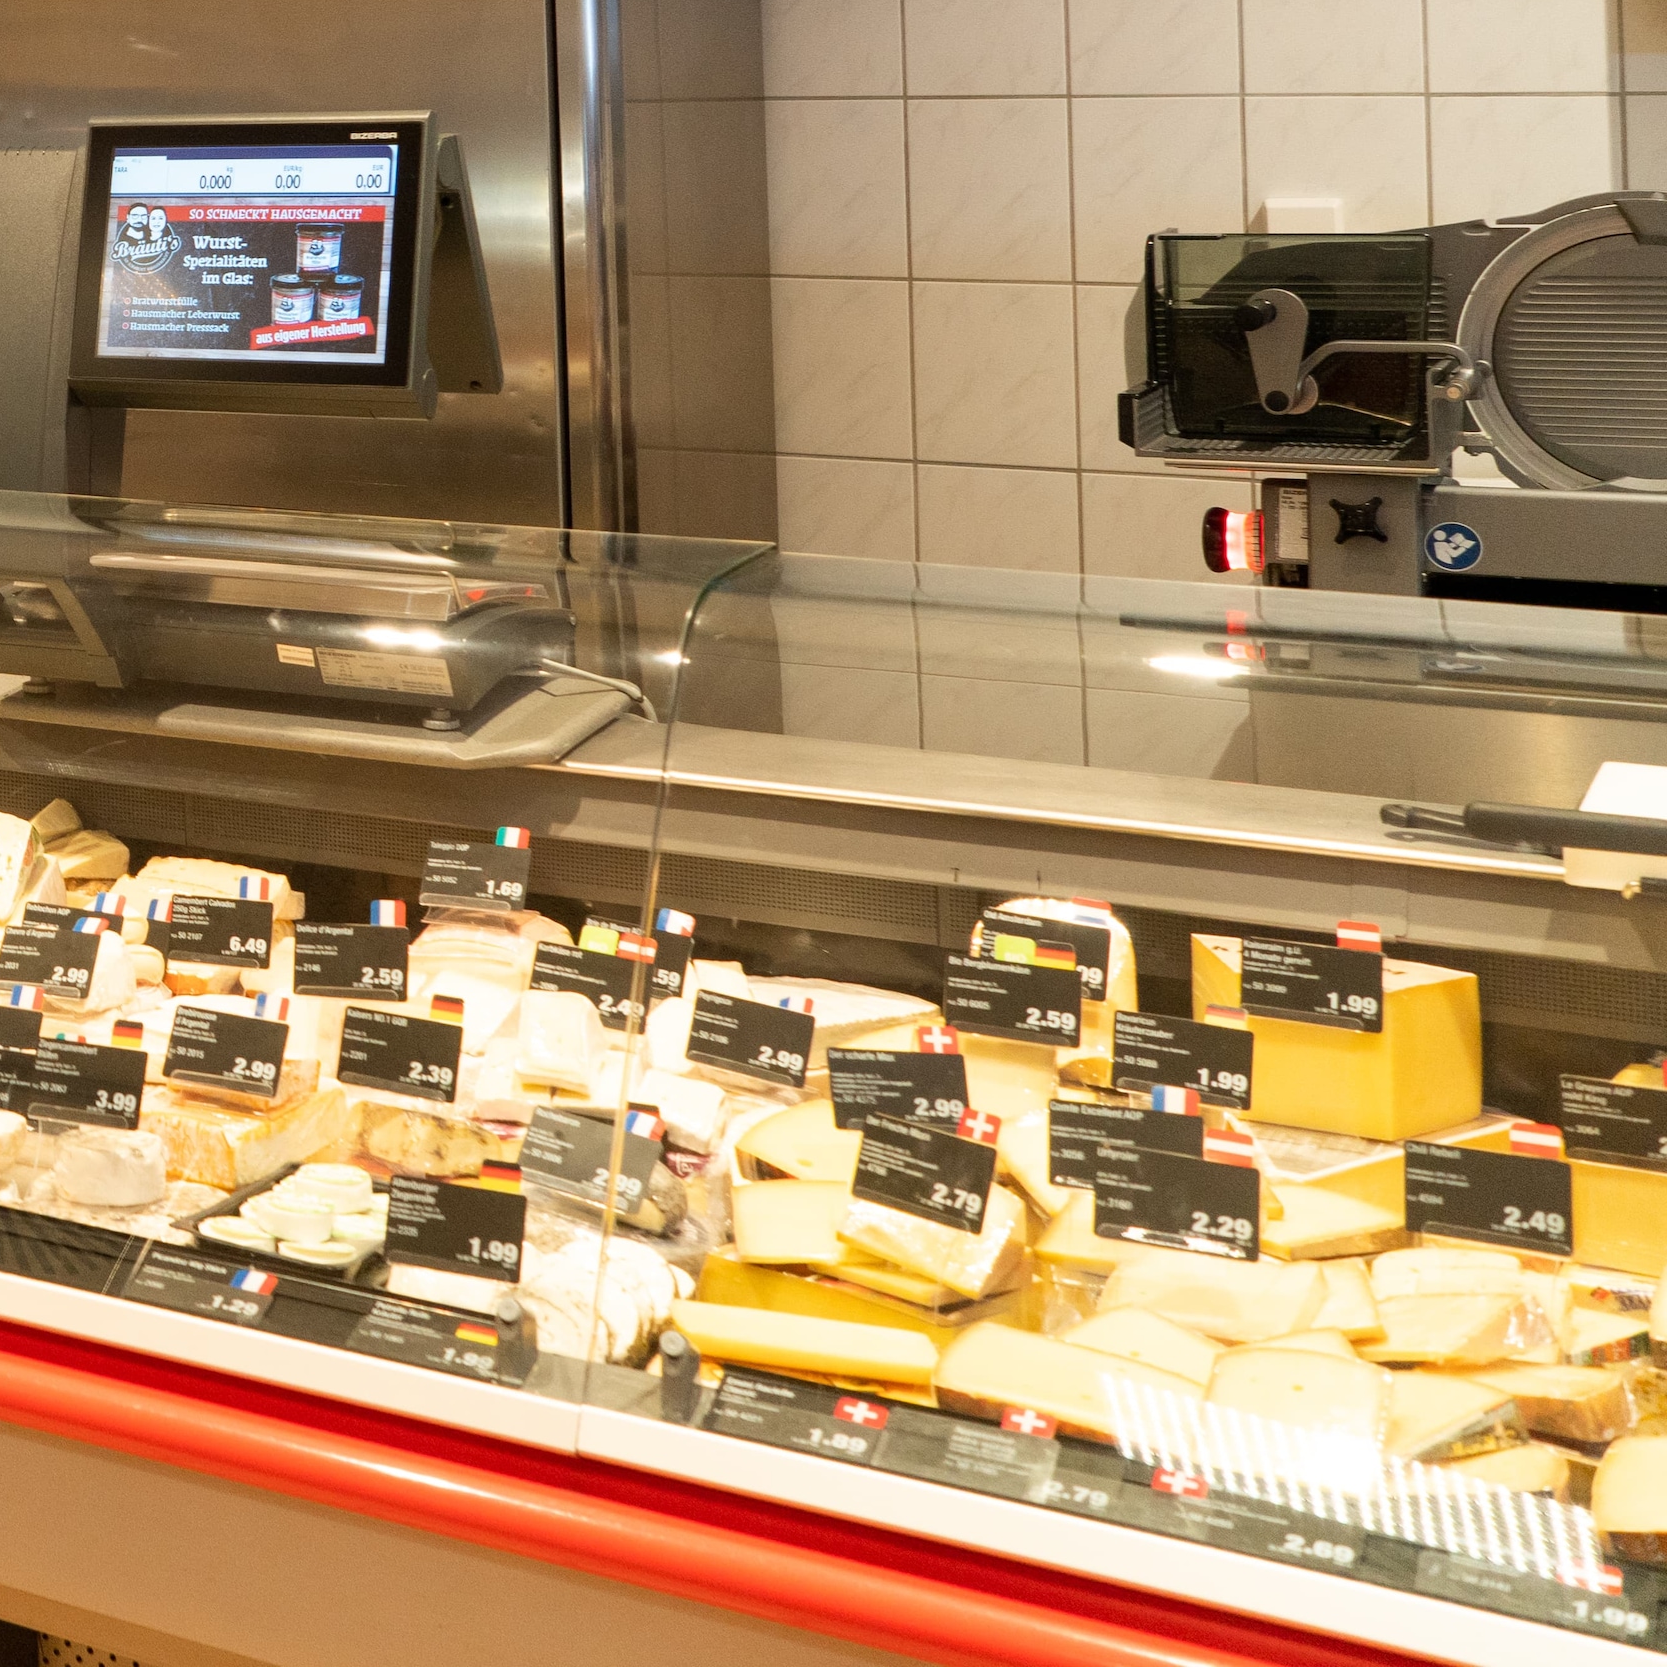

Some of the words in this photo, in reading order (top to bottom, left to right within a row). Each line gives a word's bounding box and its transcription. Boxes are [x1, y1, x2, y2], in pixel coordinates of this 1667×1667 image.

[350, 132, 397, 140] BIZERBA
[199, 174, 232, 191] 0,000
[275, 174, 301, 190] 0,00
[356, 174, 382, 190] 0,00
[189, 208, 204, 220] SO
[206, 208, 268, 221] SCHMECKT
[270, 208, 362, 220] HAUSGEMACHT
[192, 235, 248, 251] Wurst-
[183, 254, 267, 271] Spezialitäten
[202, 272, 220, 285] im
[222, 271, 254, 285] Glas:
[132, 296, 198, 307] Bratwurstfülle
[131, 308, 185, 319] Hausmacher
[187, 309, 240, 320] Leberwurst
[130, 322, 185, 333] Hausmacher
[187, 322, 229, 333] Presssack
[256, 332, 272, 344] aus
[273, 328, 310, 344] eigener
[311, 321, 366, 340] Herstellung
[485, 879, 523, 898] 1.69
[173, 896, 207, 908] Camembert
[208, 899, 236, 910] Calvados
[296, 923, 318, 934] Delice
[229, 935, 267, 954] 6.49
[51, 966, 89, 983] 2.99
[361, 966, 405, 986] 2.59
[1325, 991, 1378, 1015] 1.99
[1025, 1006, 1077, 1031] 2.59
[232, 1056, 276, 1080] 2.99
[757, 1044, 804, 1072] 2.99
[408, 1061, 454, 1086] 2.39
[1197, 1067, 1248, 1093] 1.99
[95, 1089, 136, 1112] 3.99
[913, 1096, 965, 1119] 2.99
[930, 1182, 983, 1215] 2.79
[1191, 1210, 1254, 1241] 2.29
[1502, 1205, 1565, 1235] 2.49
[467, 1236, 519, 1265] 1.99
[210, 1293, 260, 1317] 1.29
[441, 1346, 495, 1370] 1.99
[807, 1427, 869, 1455] 1.89
[1040, 1478, 1110, 1508] 2.79
[1282, 1532, 1356, 1564] 2.69
[1571, 1600, 1650, 1633] 1.99
